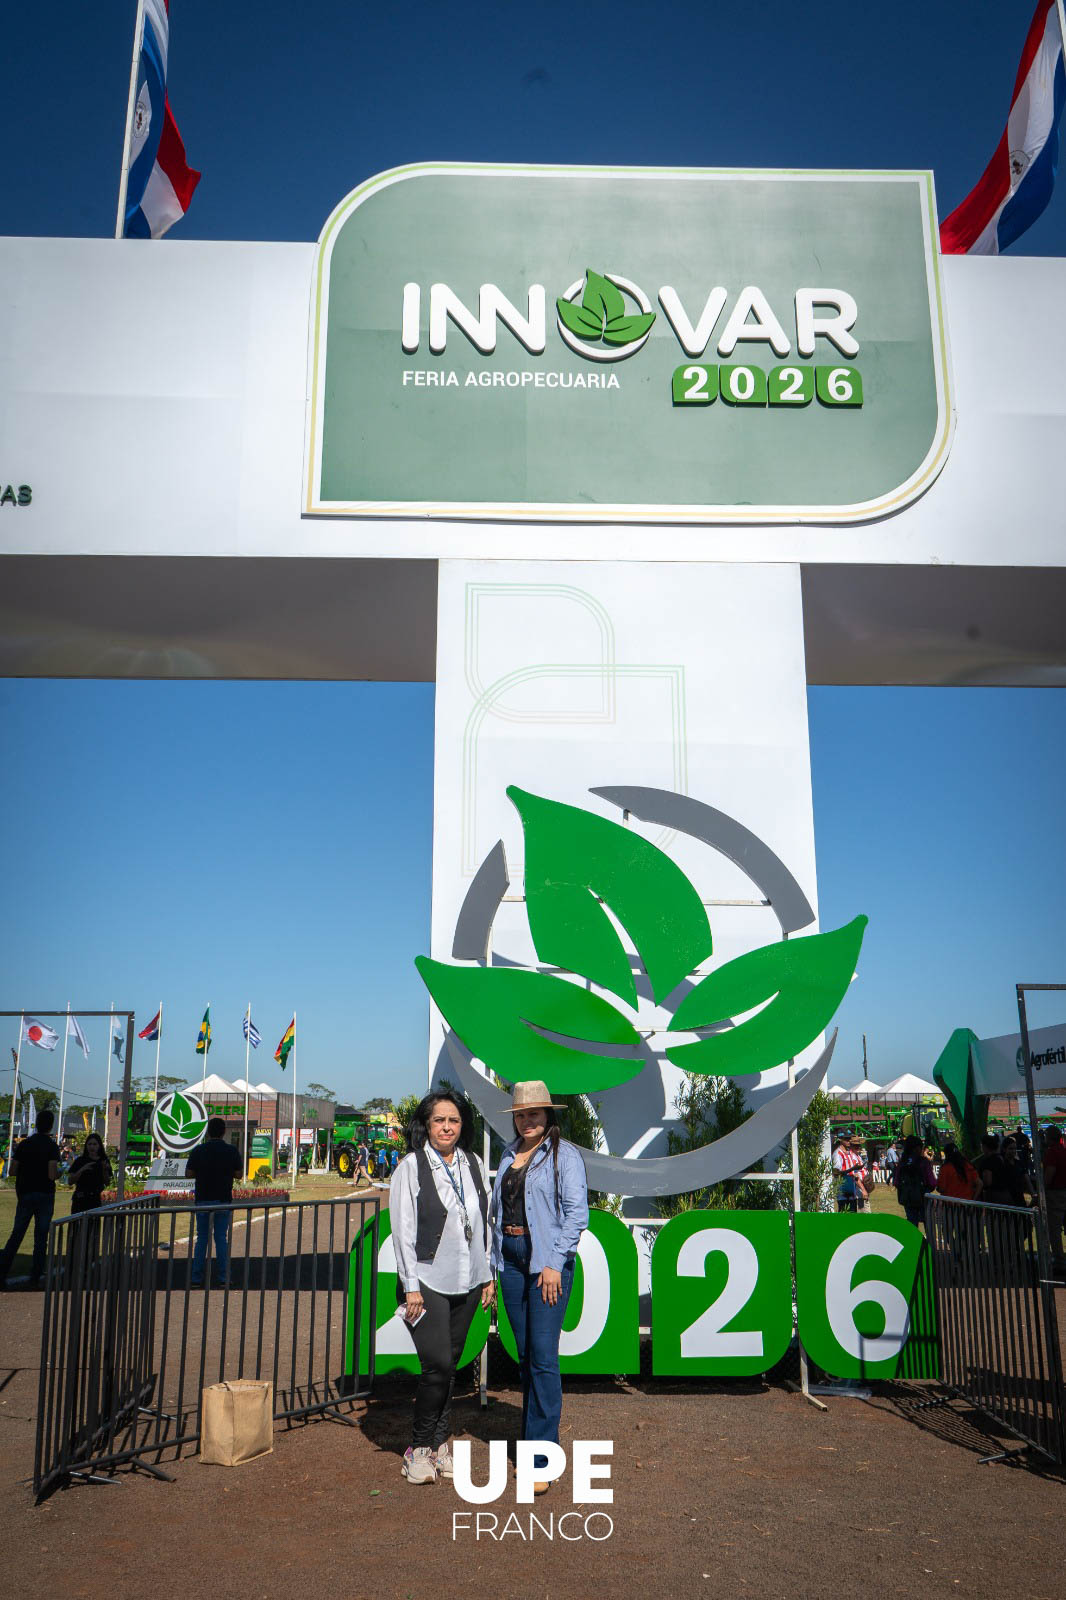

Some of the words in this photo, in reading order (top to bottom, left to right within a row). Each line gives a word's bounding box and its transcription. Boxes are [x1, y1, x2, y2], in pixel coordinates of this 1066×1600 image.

[402, 269, 860, 362] INNOVAR
[402, 370, 459, 387] FERIA
[464, 371, 620, 389] AGROPECUARIA
[683, 366, 853, 402] 2026
[0, 484, 32, 506] AS
